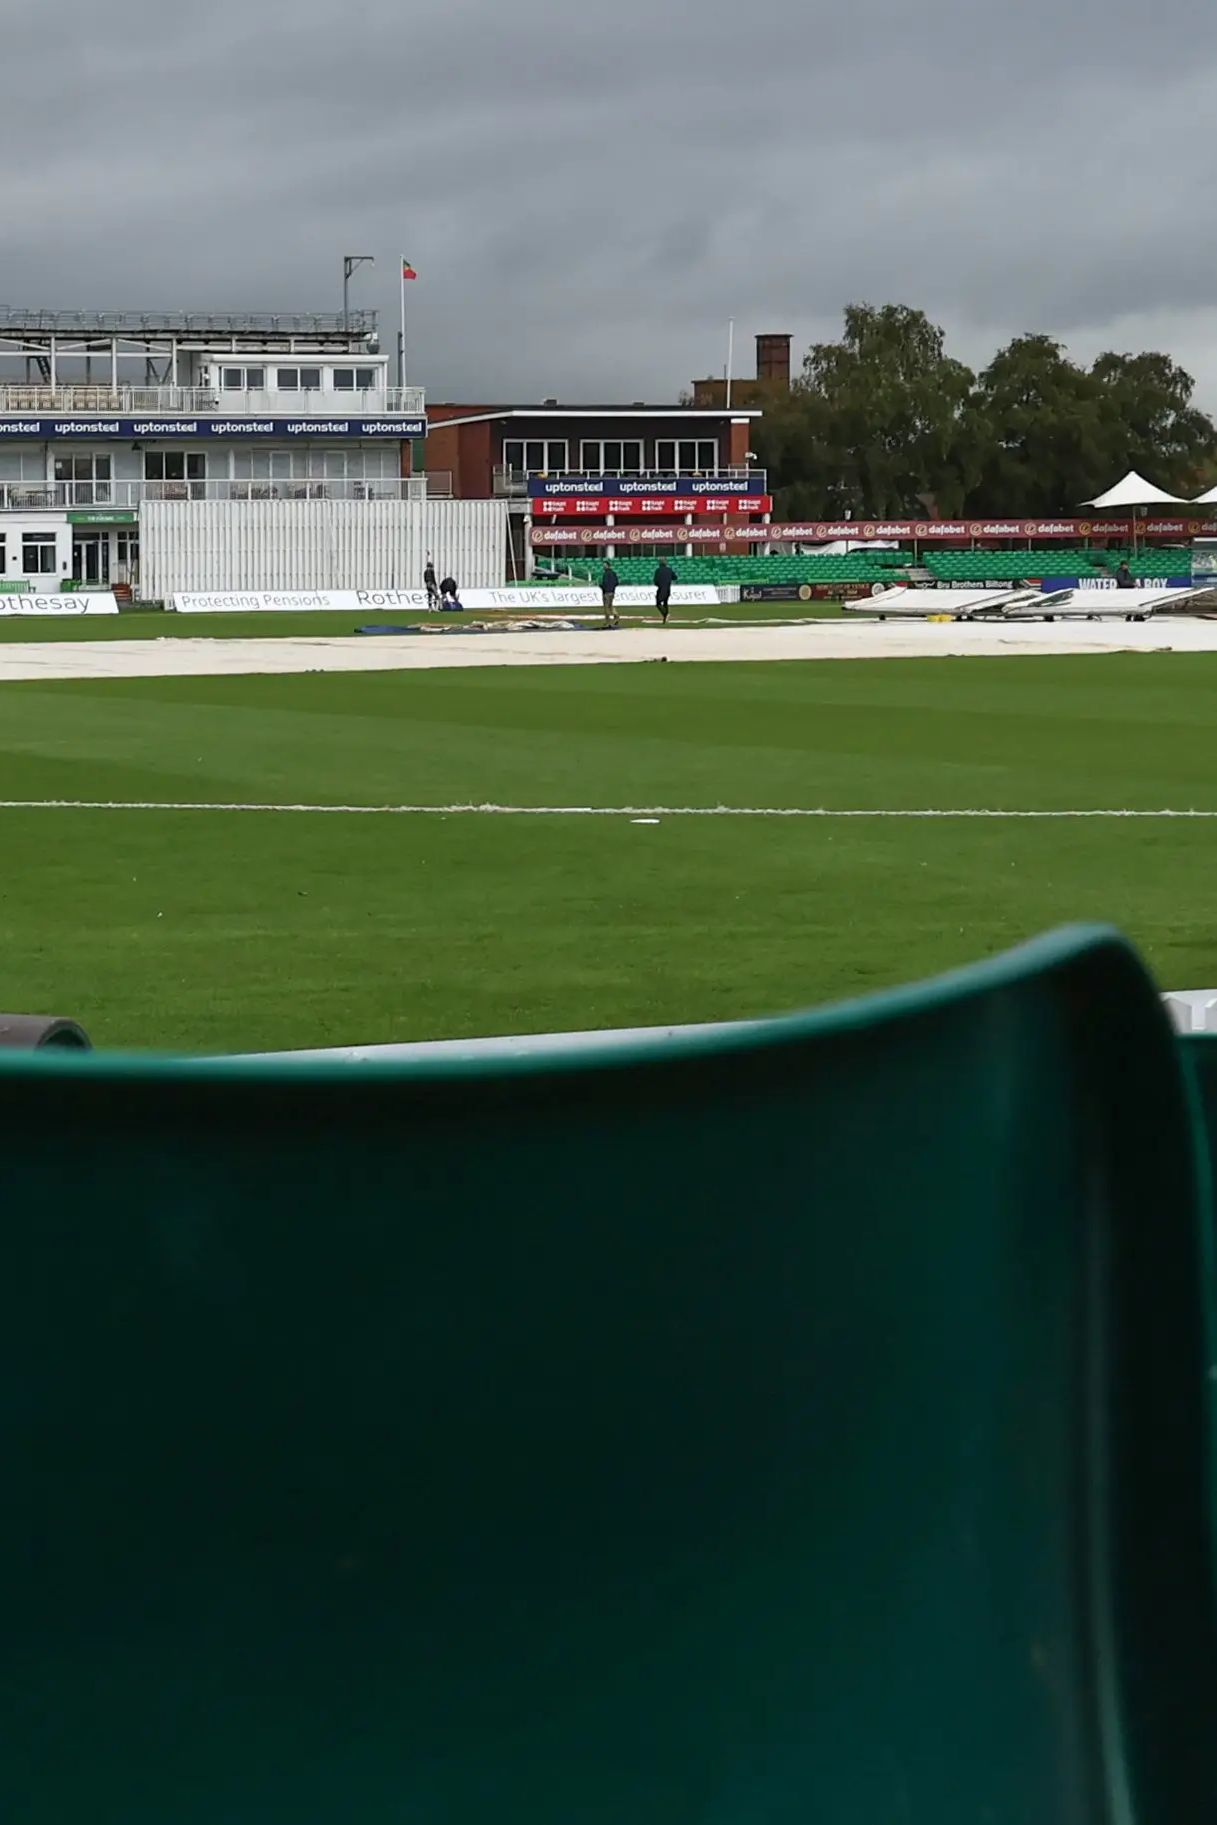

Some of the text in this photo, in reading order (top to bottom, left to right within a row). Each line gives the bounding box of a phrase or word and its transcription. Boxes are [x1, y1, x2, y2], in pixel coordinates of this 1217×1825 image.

[54, 422, 120, 434] uptonsteel
[133, 422, 197, 434] uptonsteel
[211, 422, 273, 434] uptonsteel
[287, 422, 348, 434] uptonsteel
[362, 422, 422, 434] uptonsteel
[545, 482, 603, 493] uptonsteel
[619, 481, 677, 493] uptonsteel
[692, 481, 748, 493] uptonsteel
[688, 528, 721, 538] dafabet
[736, 528, 768, 538] dafabet
[782, 527, 813, 537] dafabet
[827, 526, 859, 536] dafabet
[876, 525, 911, 535] dafabet
[928, 525, 965, 535] dafabet
[983, 524, 1020, 534] dafabet
[1038, 524, 1075, 534] dafabet
[1092, 524, 1129, 533] dafabet
[1146, 523, 1183, 533] dafabet
[544, 530, 577, 540] dafabet
[593, 530, 625, 540] dafabet
[641, 529, 673, 539] dafabet
[182, 594, 331, 609] Protecting Pensions
[356, 590, 436, 605] Rothe
[490, 589, 707, 605] The UK's largest ension surer
